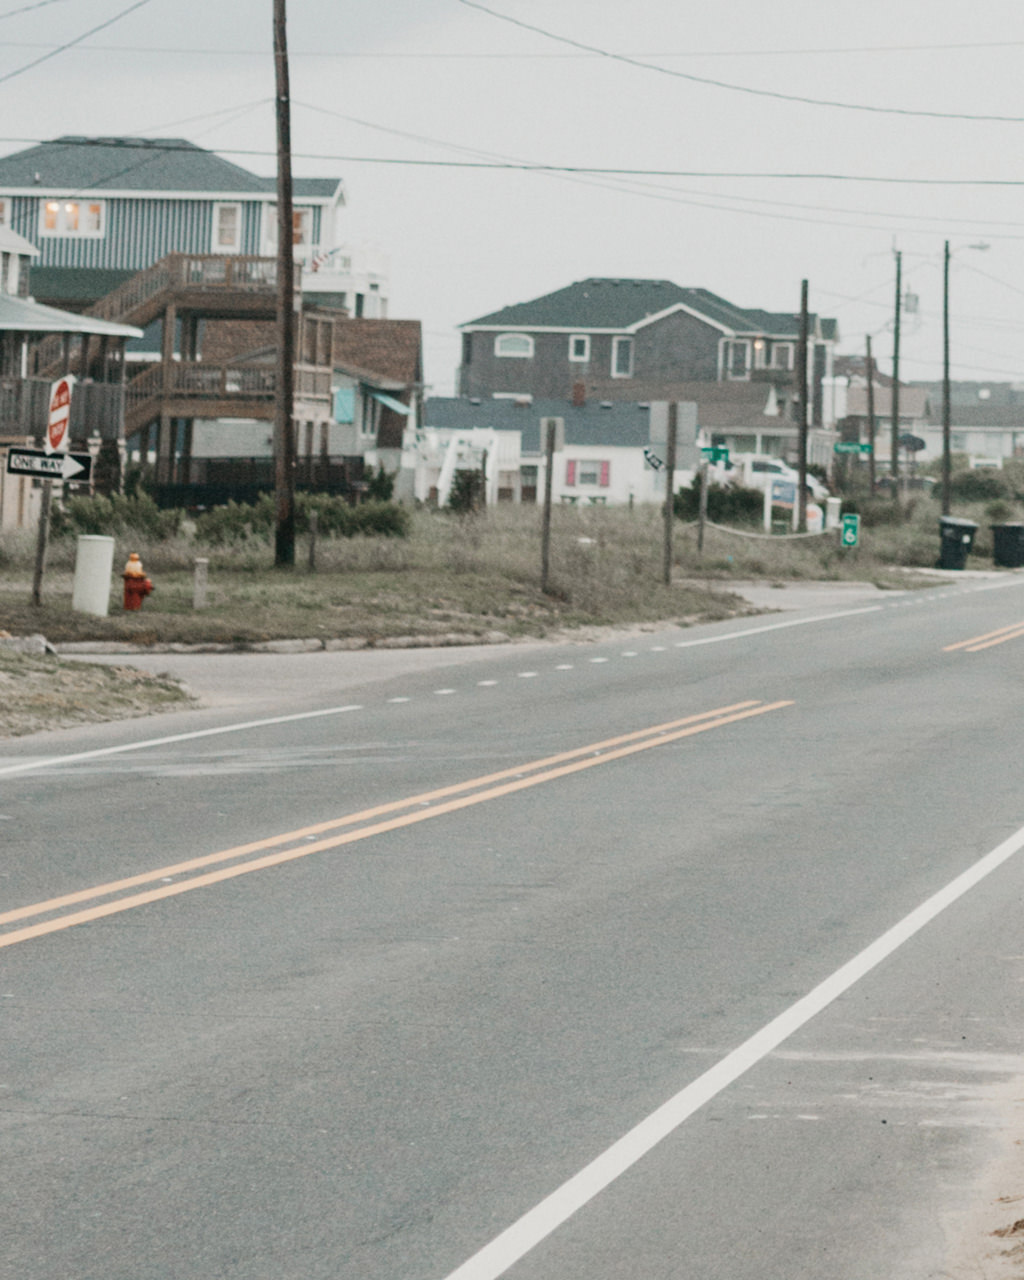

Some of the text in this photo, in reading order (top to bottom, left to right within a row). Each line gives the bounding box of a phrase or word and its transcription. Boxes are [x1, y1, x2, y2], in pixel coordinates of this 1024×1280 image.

[14, 455, 63, 470] ONE WAY
[845, 528, 855, 543] 6
